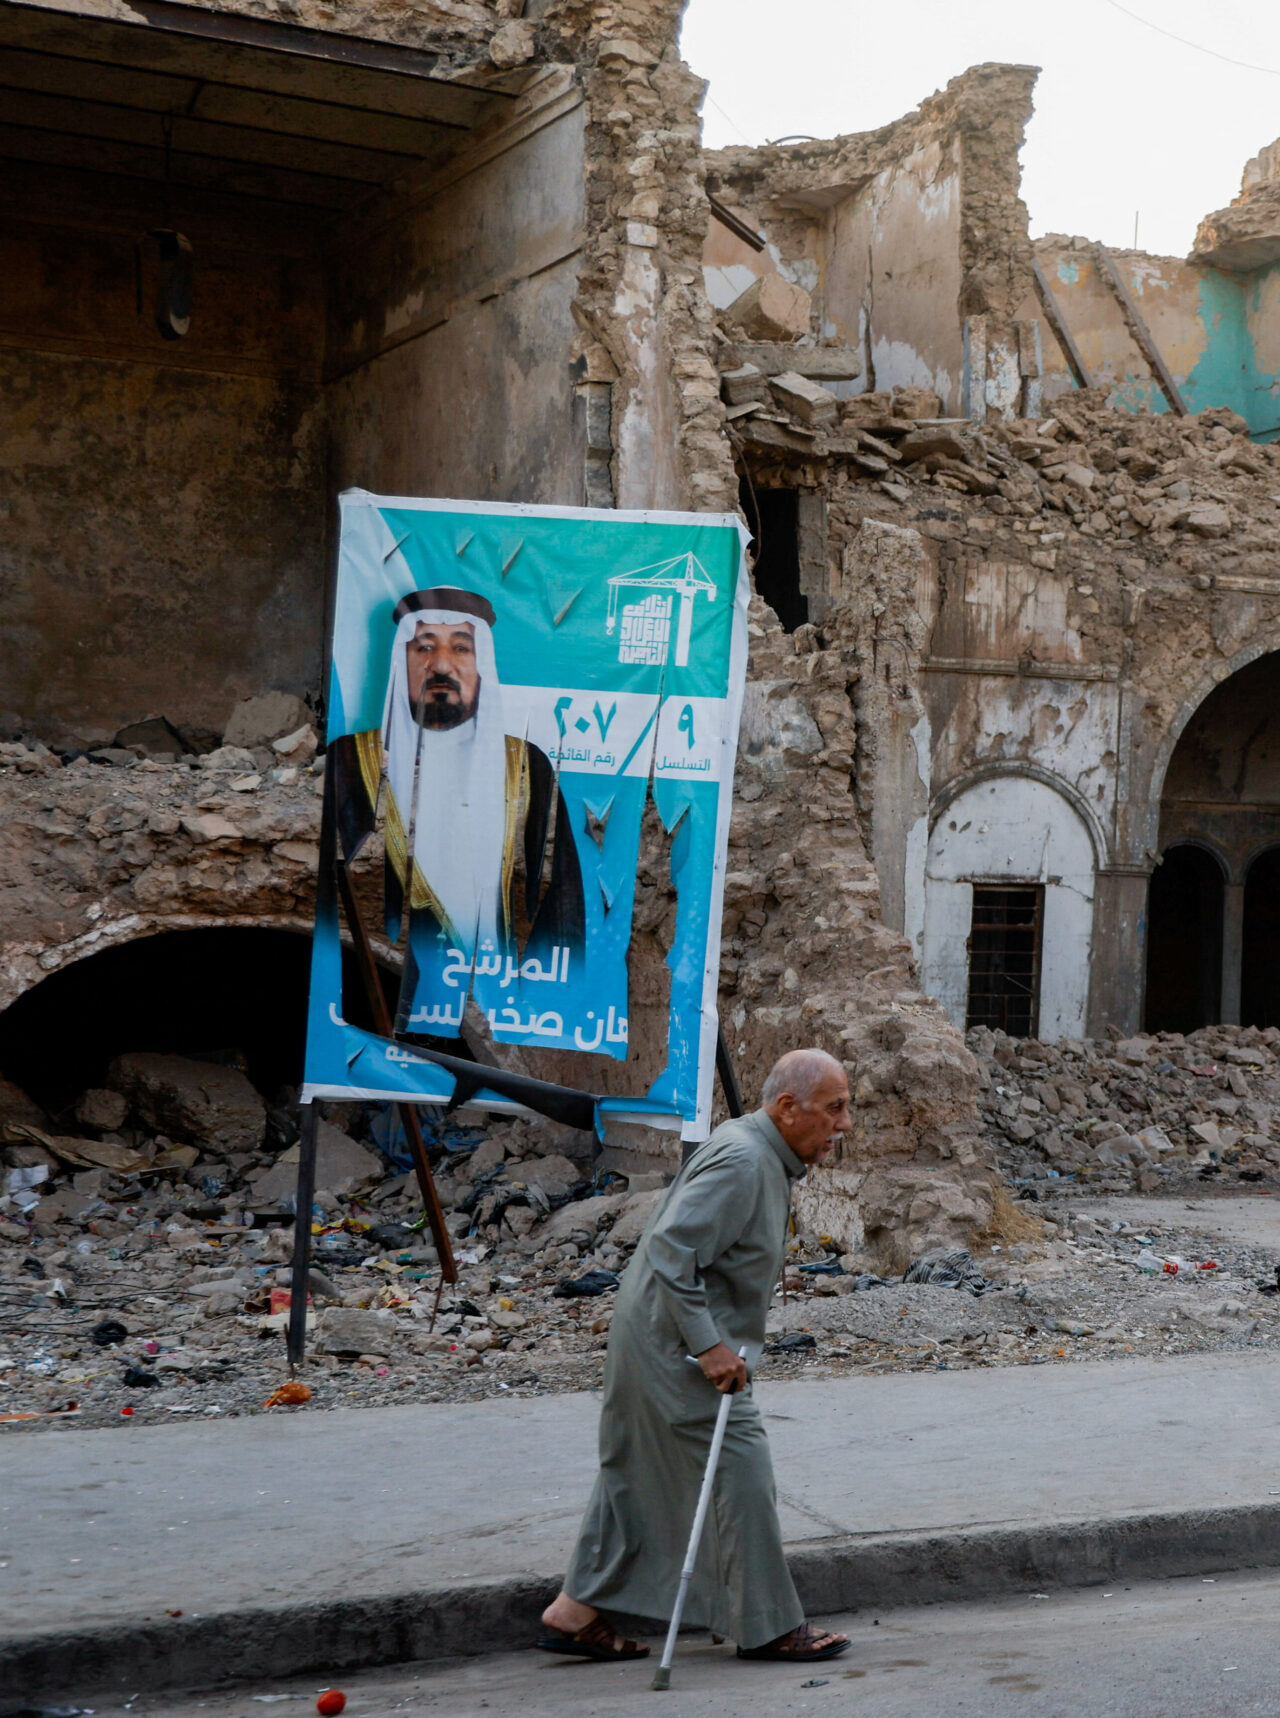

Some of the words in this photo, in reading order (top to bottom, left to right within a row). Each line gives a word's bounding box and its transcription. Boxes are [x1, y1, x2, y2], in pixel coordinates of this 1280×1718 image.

[553, 696, 617, 744] ٢٠٧
[677, 703, 696, 750] ٩
[548, 746, 591, 762] القائمة
[593, 751, 616, 767] رقم
[655, 755, 711, 771] التسلسل
[442, 938, 570, 988] المرشح
